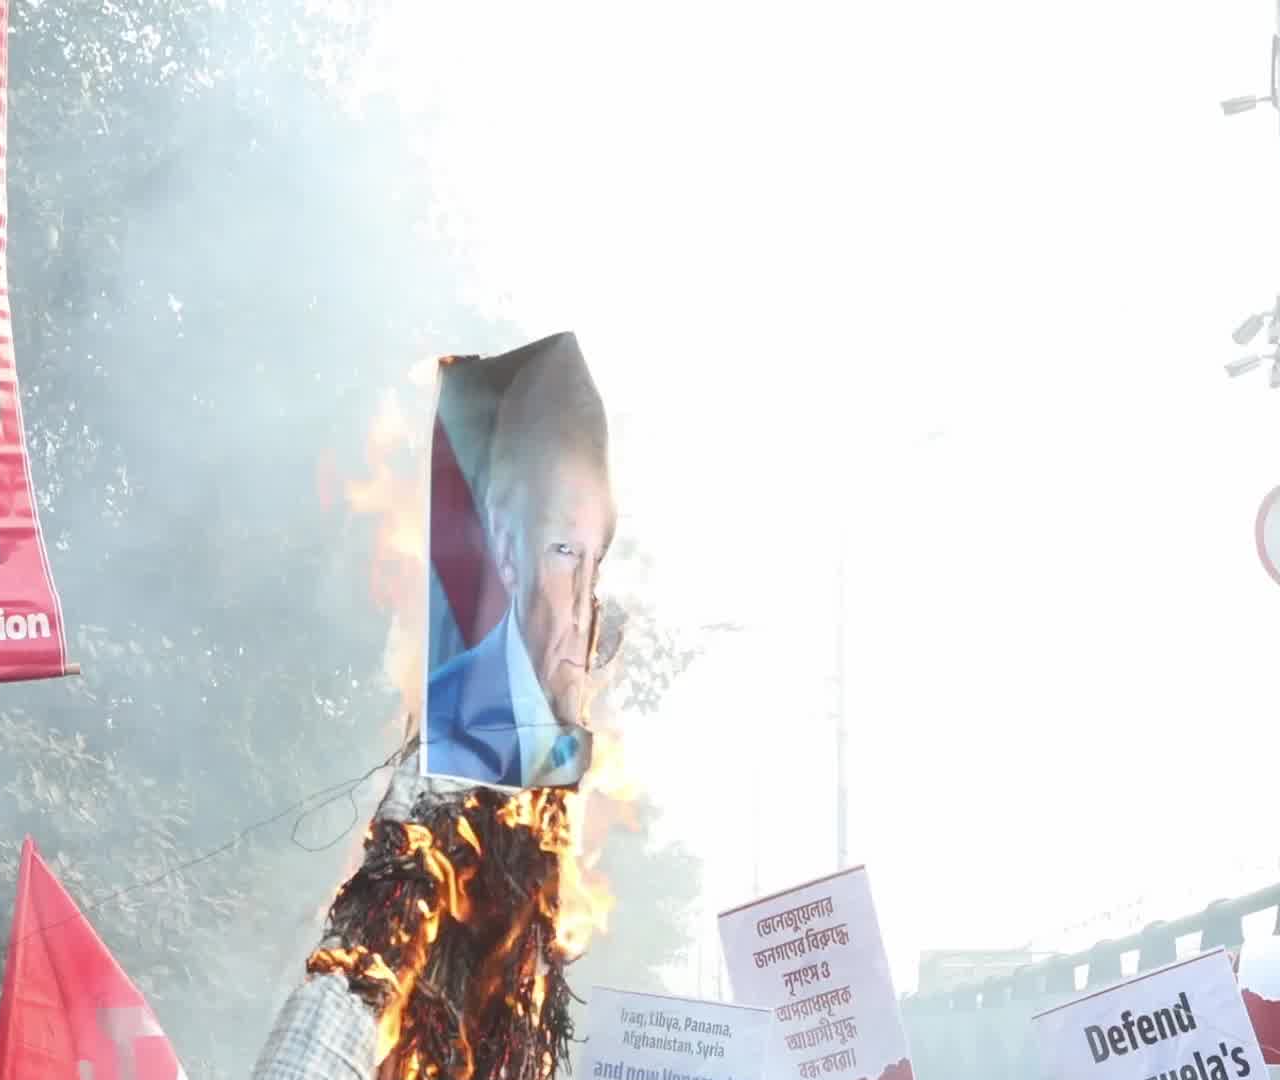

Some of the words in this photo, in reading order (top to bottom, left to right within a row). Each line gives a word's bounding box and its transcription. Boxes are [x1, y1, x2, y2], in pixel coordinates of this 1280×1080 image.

[649, 1011, 682, 1033] Libya,
[684, 1017, 732, 1039] Panama,
[1084, 991, 1197, 1064] Defend
[623, 1031, 695, 1055] Afghanistan,
[696, 1040, 725, 1060] Syria
[593, 1060, 624, 1080] and
